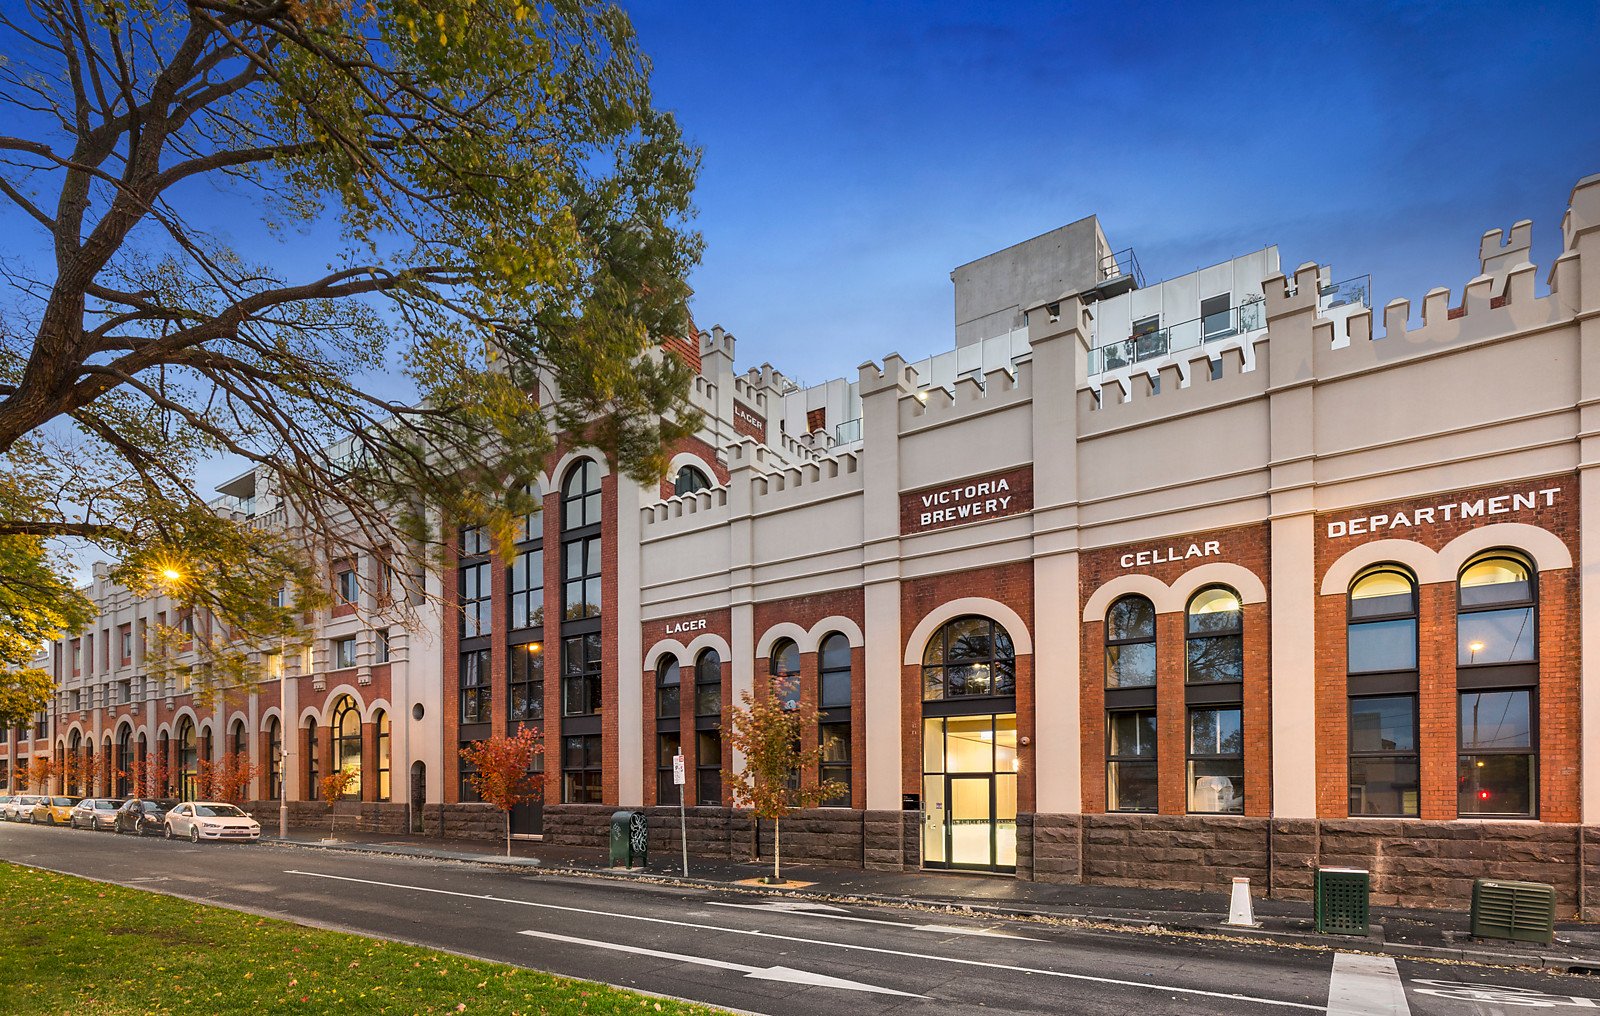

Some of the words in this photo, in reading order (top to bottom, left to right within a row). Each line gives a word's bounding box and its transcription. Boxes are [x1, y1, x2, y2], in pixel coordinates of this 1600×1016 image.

[734, 405, 763, 430] LAGER
[921, 478, 1010, 508] VICTORIA
[920, 495, 1012, 526] BREWERY
[1327, 487, 1562, 539] DEPARTMENT
[1120, 540, 1221, 568] CELLAR
[665, 619, 707, 634] LAGER
